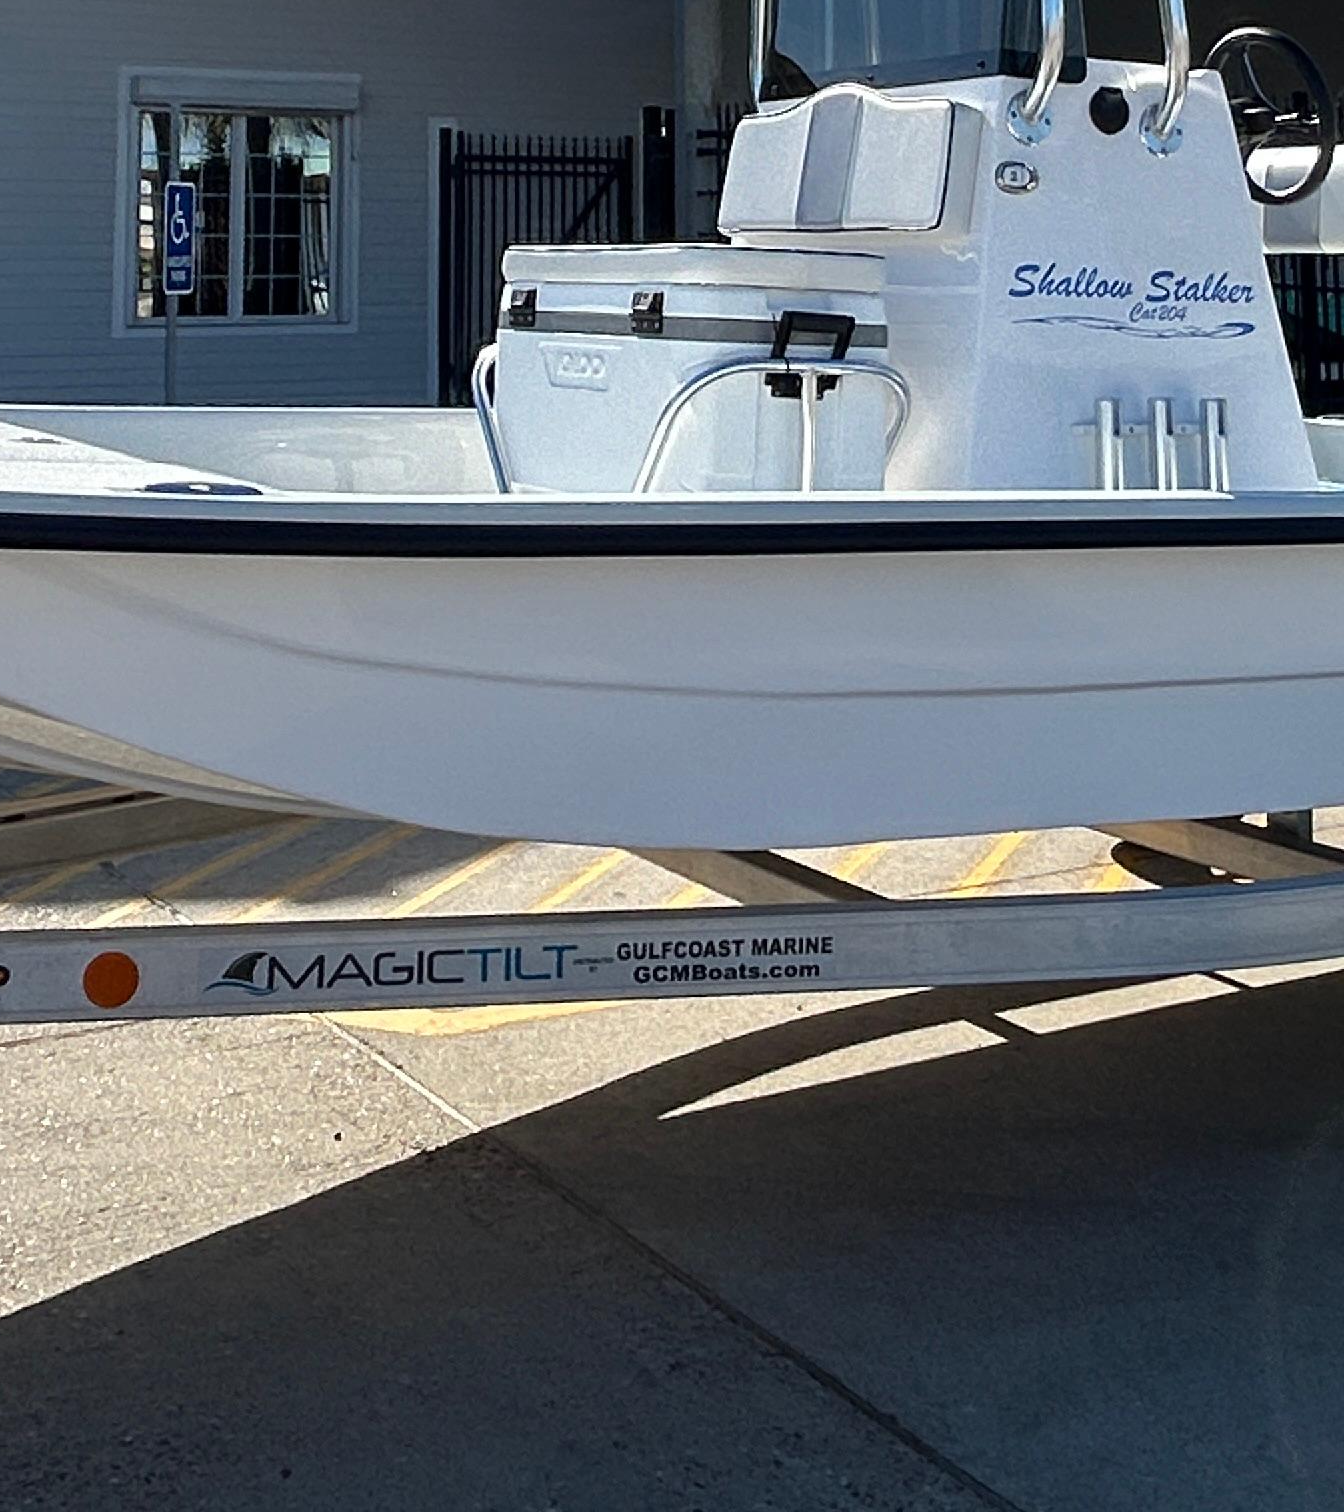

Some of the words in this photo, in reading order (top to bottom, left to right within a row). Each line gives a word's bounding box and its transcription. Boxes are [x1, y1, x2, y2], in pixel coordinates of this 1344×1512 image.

[1008, 263, 1134, 298] Shallow
[1145, 270, 1255, 304] Stalker
[267, 945, 578, 990] MAGICTILT
[616, 939, 745, 962] GULFCOAST
[751, 937, 834, 956] MARINE
[633, 962, 820, 984] GCMBoats.com
